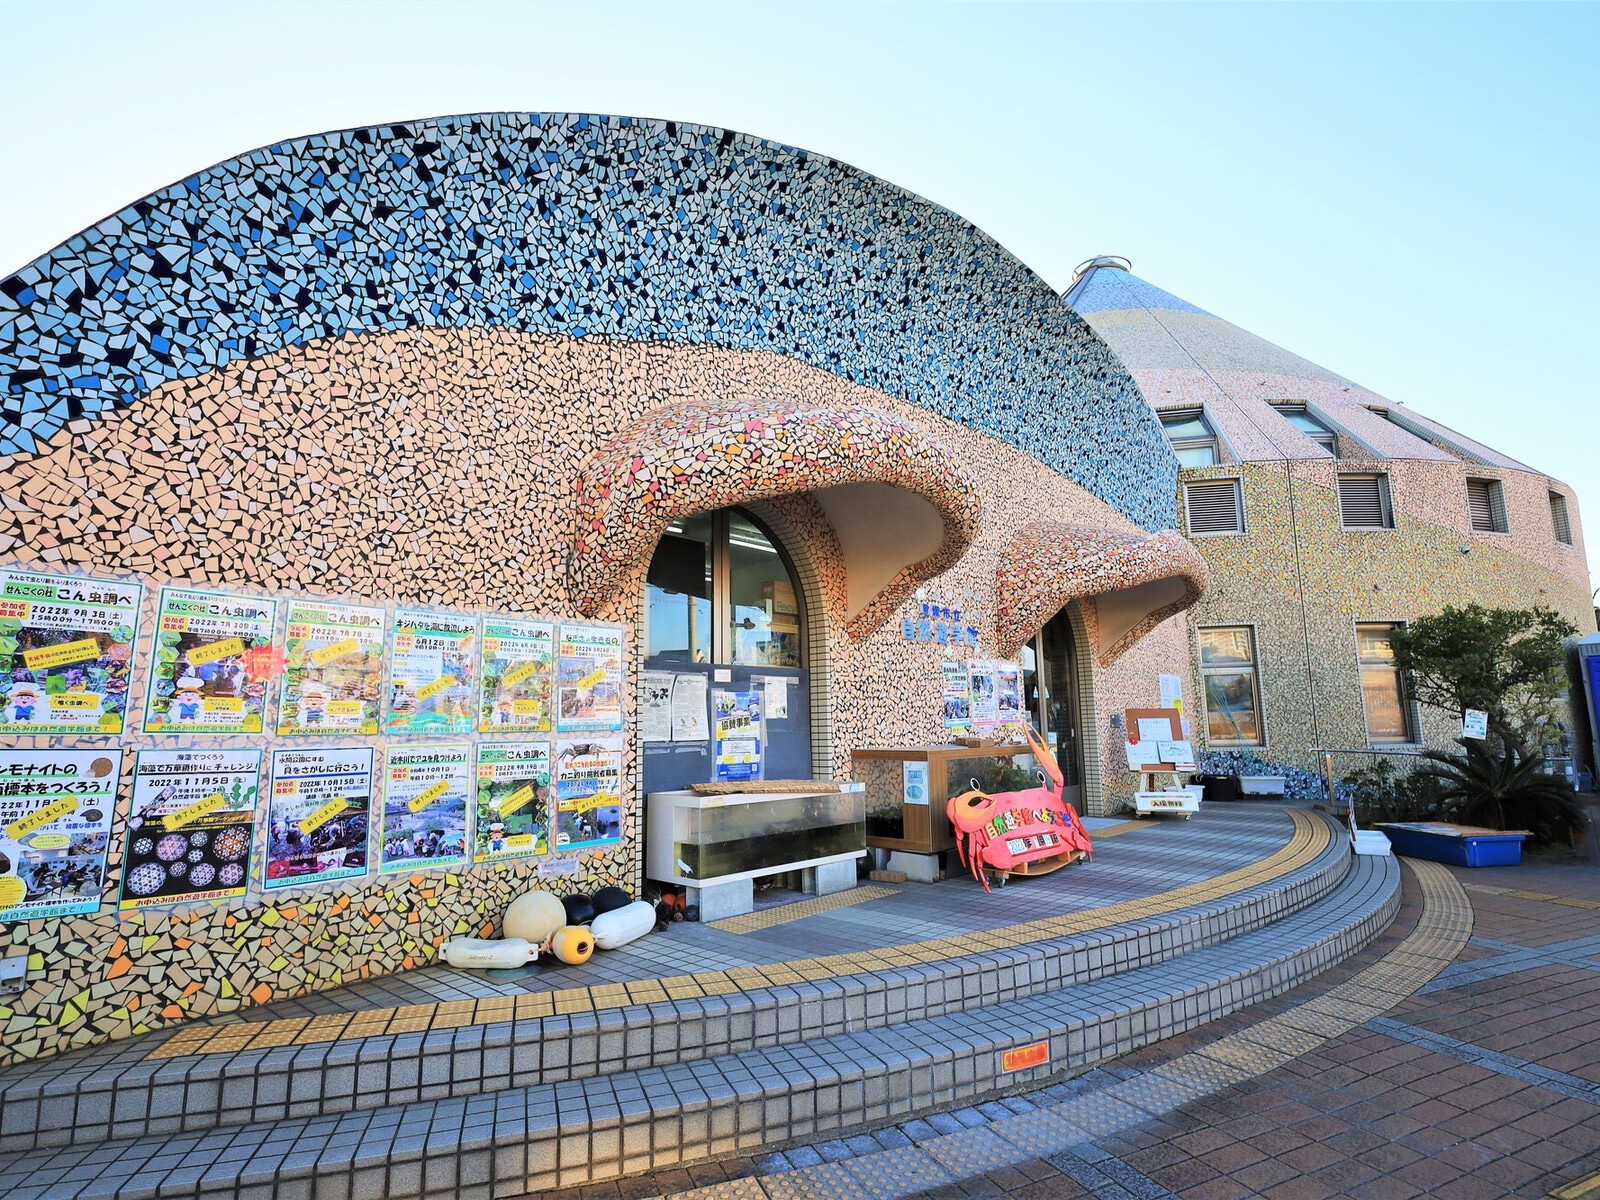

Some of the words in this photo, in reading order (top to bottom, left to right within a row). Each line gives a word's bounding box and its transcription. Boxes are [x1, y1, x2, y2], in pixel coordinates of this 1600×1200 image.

[57, 587, 132, 605] こん虫調べ
[208, 604, 268, 619] こん虫調べ
[328, 612, 380, 626] こん虫調べ
[512, 628, 550, 638] こん虫調べ
[195, 643, 236, 660] 終了しました
[0, 725, 108, 733] 申込みは自然遊学館まで！
[507, 749, 546, 759] こん虫調べ
[283, 763, 365, 775] 貝をさがしに行こう！
[0, 781, 111, 796] 標本をつくろう！
[415, 785, 444, 805] 終了しました
[18, 803, 69, 831] 終了しました
[174, 799, 217, 821] 終了しました
[306, 803, 341, 827] 終了しました
